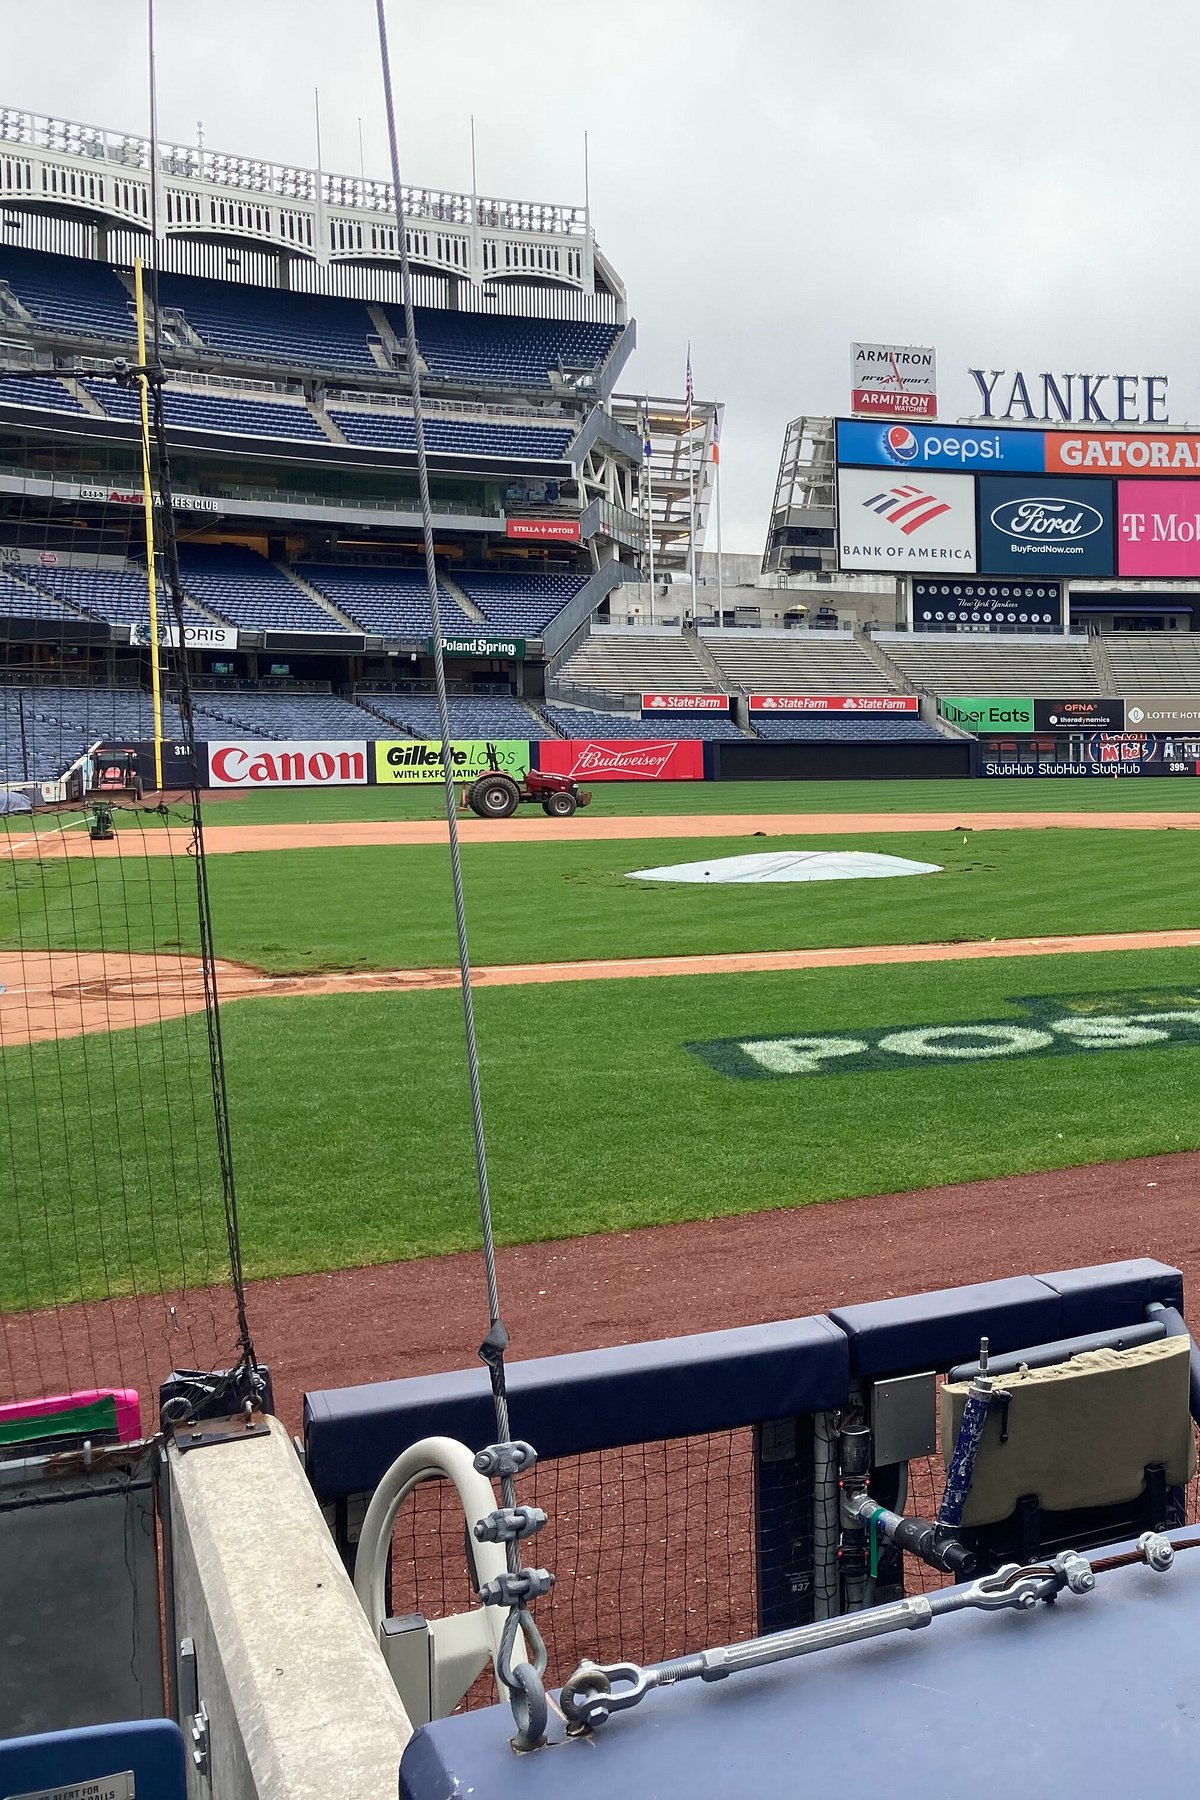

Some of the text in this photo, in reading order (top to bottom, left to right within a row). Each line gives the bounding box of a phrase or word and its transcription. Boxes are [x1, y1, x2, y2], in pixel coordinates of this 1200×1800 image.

[856, 350, 933, 366] ARMITRON
[860, 393, 929, 407] ARMITRON
[967, 367, 1169, 424] YANKEE
[894, 404, 928, 414] WATCHES
[923, 436, 1002, 463] pepsi
[109, 492, 144, 504] Audi
[194, 499, 219, 511] CLUB
[1010, 502, 1083, 535] Ford
[513, 525, 574, 535] STELLA ARTOIS
[843, 545, 972, 559] BANK OF AMERICA
[1011, 543, 1084, 555] BuyFordNow.com
[184, 628, 226, 642] ORIS
[440, 638, 515, 656] Poland Spring
[945, 707, 1030, 723] Uber Eats
[1064, 704, 1094, 712] QFNA
[211, 747, 364, 783] Canon
[578, 750, 667, 768] Budweiser
[986, 763, 1034, 775] StubHub
[1038, 763, 1087, 775] StubHub
[1091, 763, 1141, 775] StubHub
[1169, 762, 1184, 772] 399
[393, 770, 419, 779] WITH
[791, 1582, 810, 1593] #37
[82, 1785, 99, 1796] FOR
